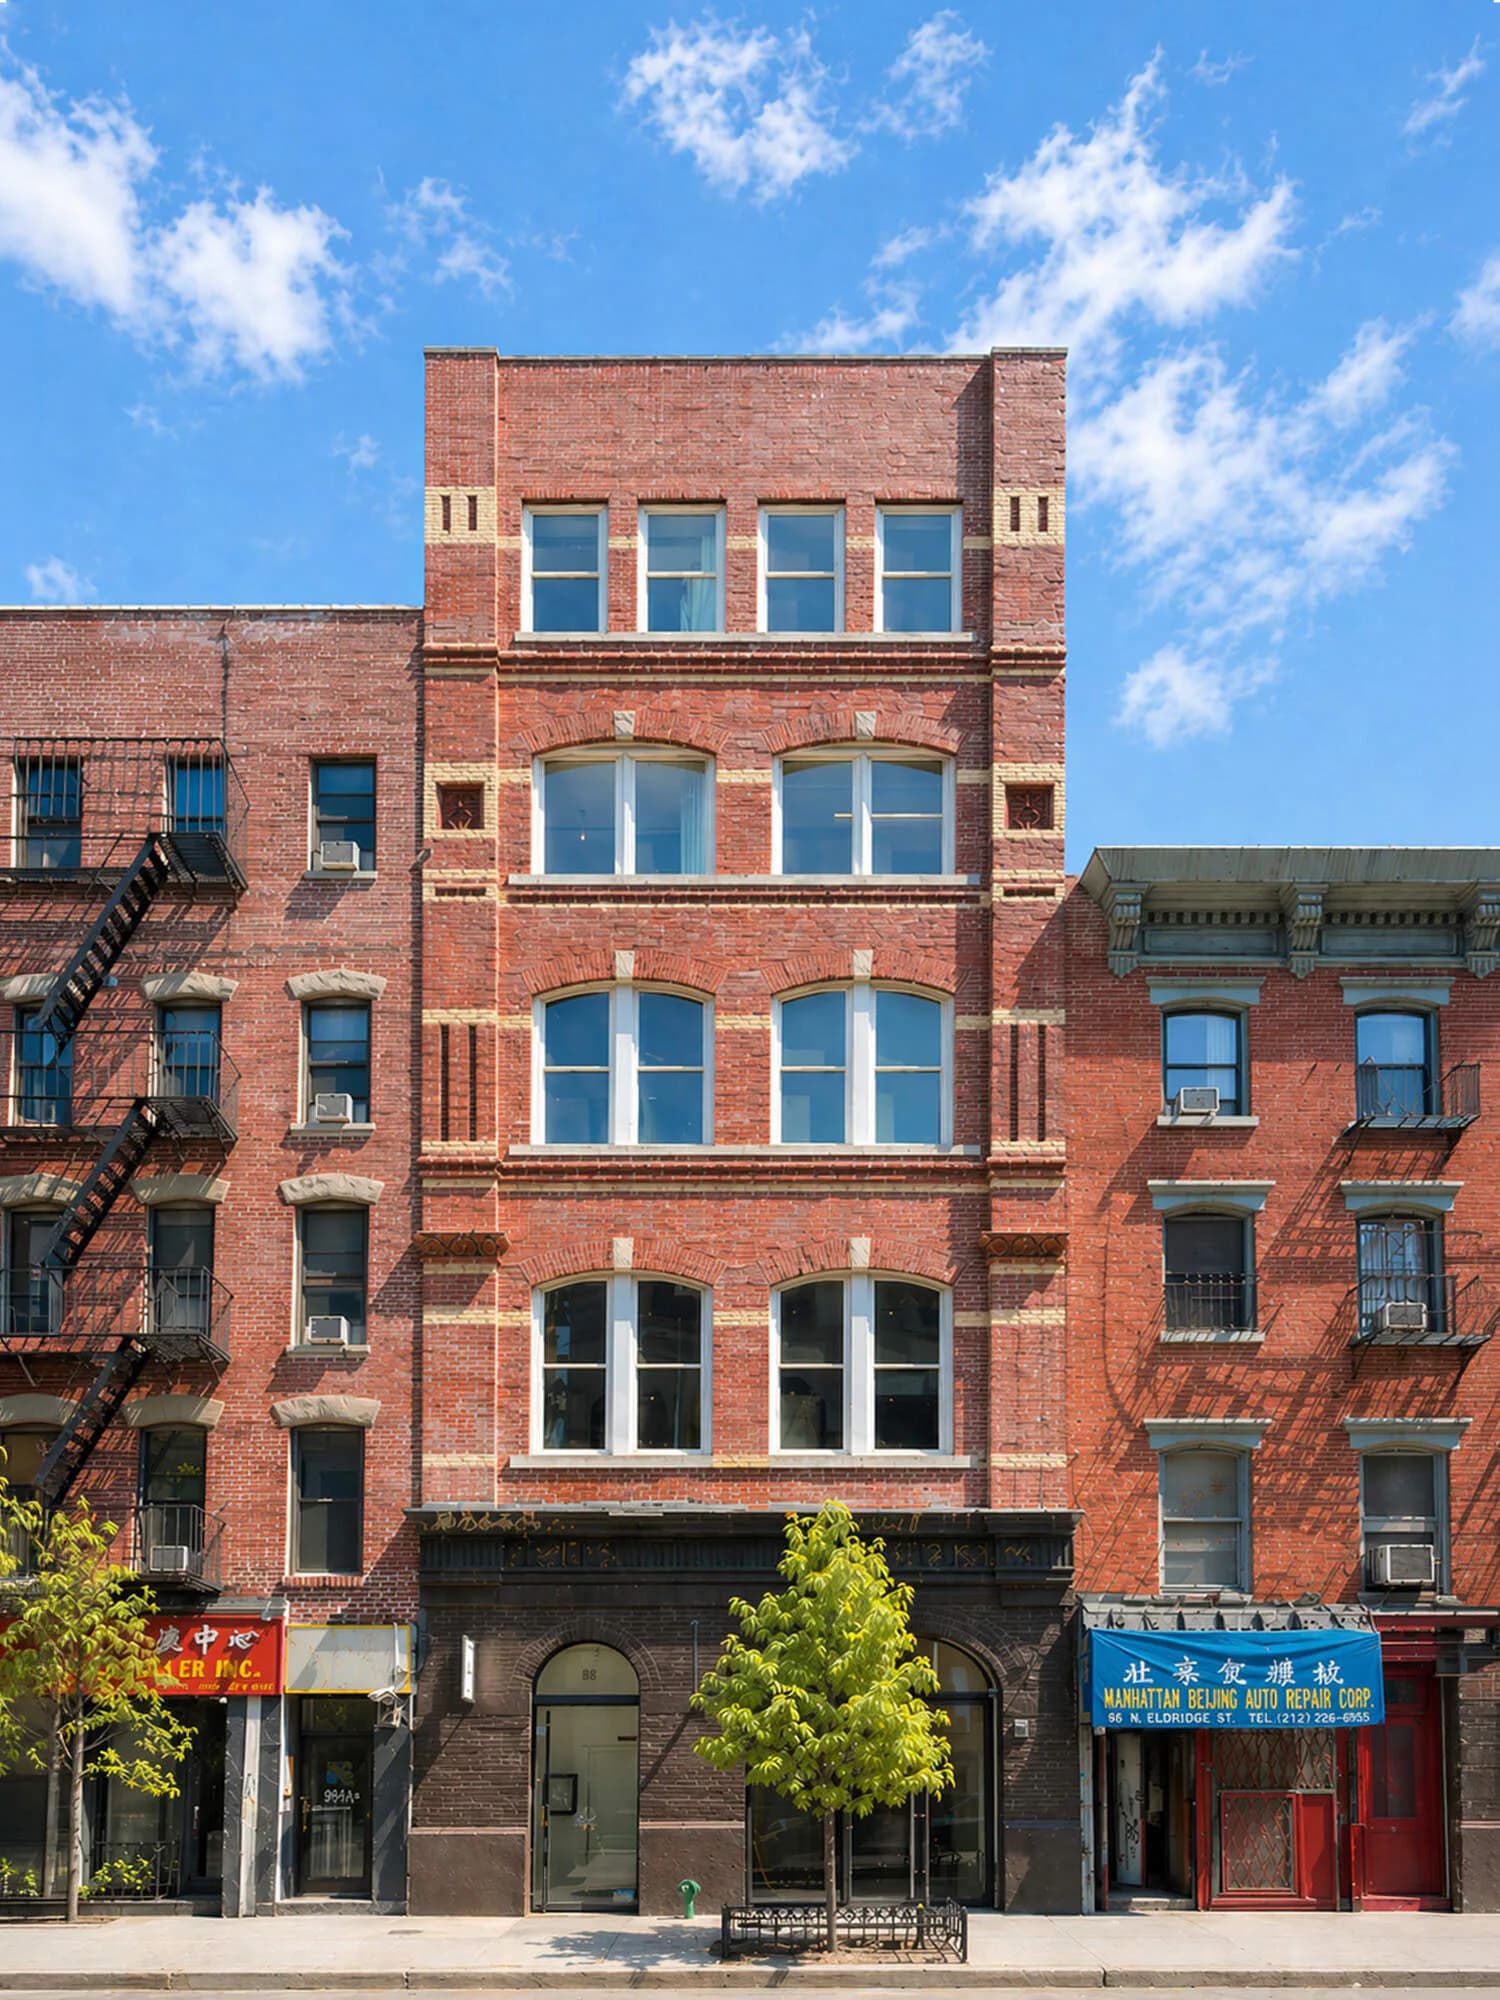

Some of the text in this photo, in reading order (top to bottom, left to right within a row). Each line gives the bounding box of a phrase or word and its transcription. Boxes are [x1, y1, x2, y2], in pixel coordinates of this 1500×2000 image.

[215, 1660, 261, 1678] INC.
[1103, 1687, 1375, 1709] MANHATTAN BEIJING AUTO REPAIR CORP.
[1146, 1712, 1211, 1724] ELDRIDGE
[1216, 1712, 1236, 1724] ST.
